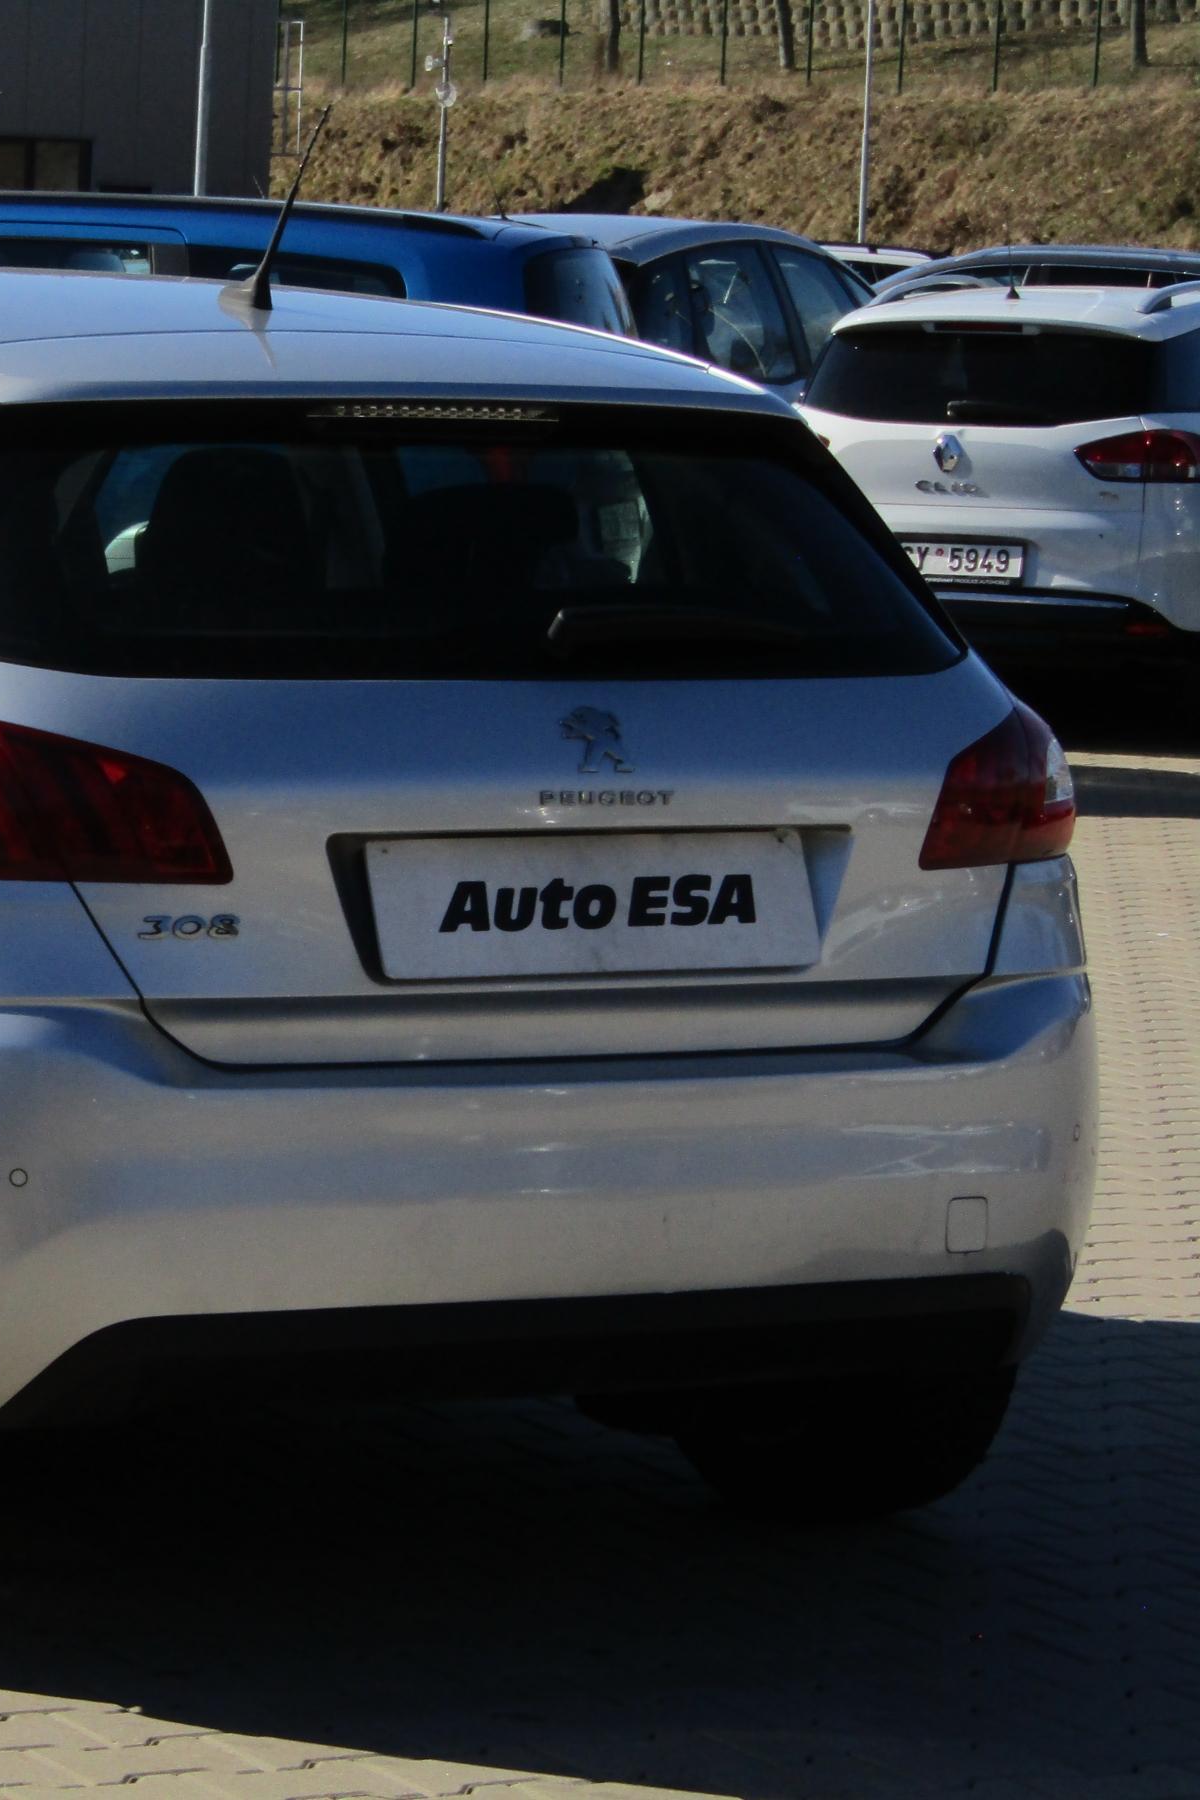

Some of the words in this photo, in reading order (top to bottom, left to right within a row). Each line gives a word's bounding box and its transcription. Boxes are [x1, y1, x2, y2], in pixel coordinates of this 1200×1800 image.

[949, 547, 1010, 573] 5949
[540, 790, 674, 806] PEUGEOT
[438, 878, 617, 933] Auto
[627, 874, 756, 927] ESA
[137, 914, 240, 940] 308
